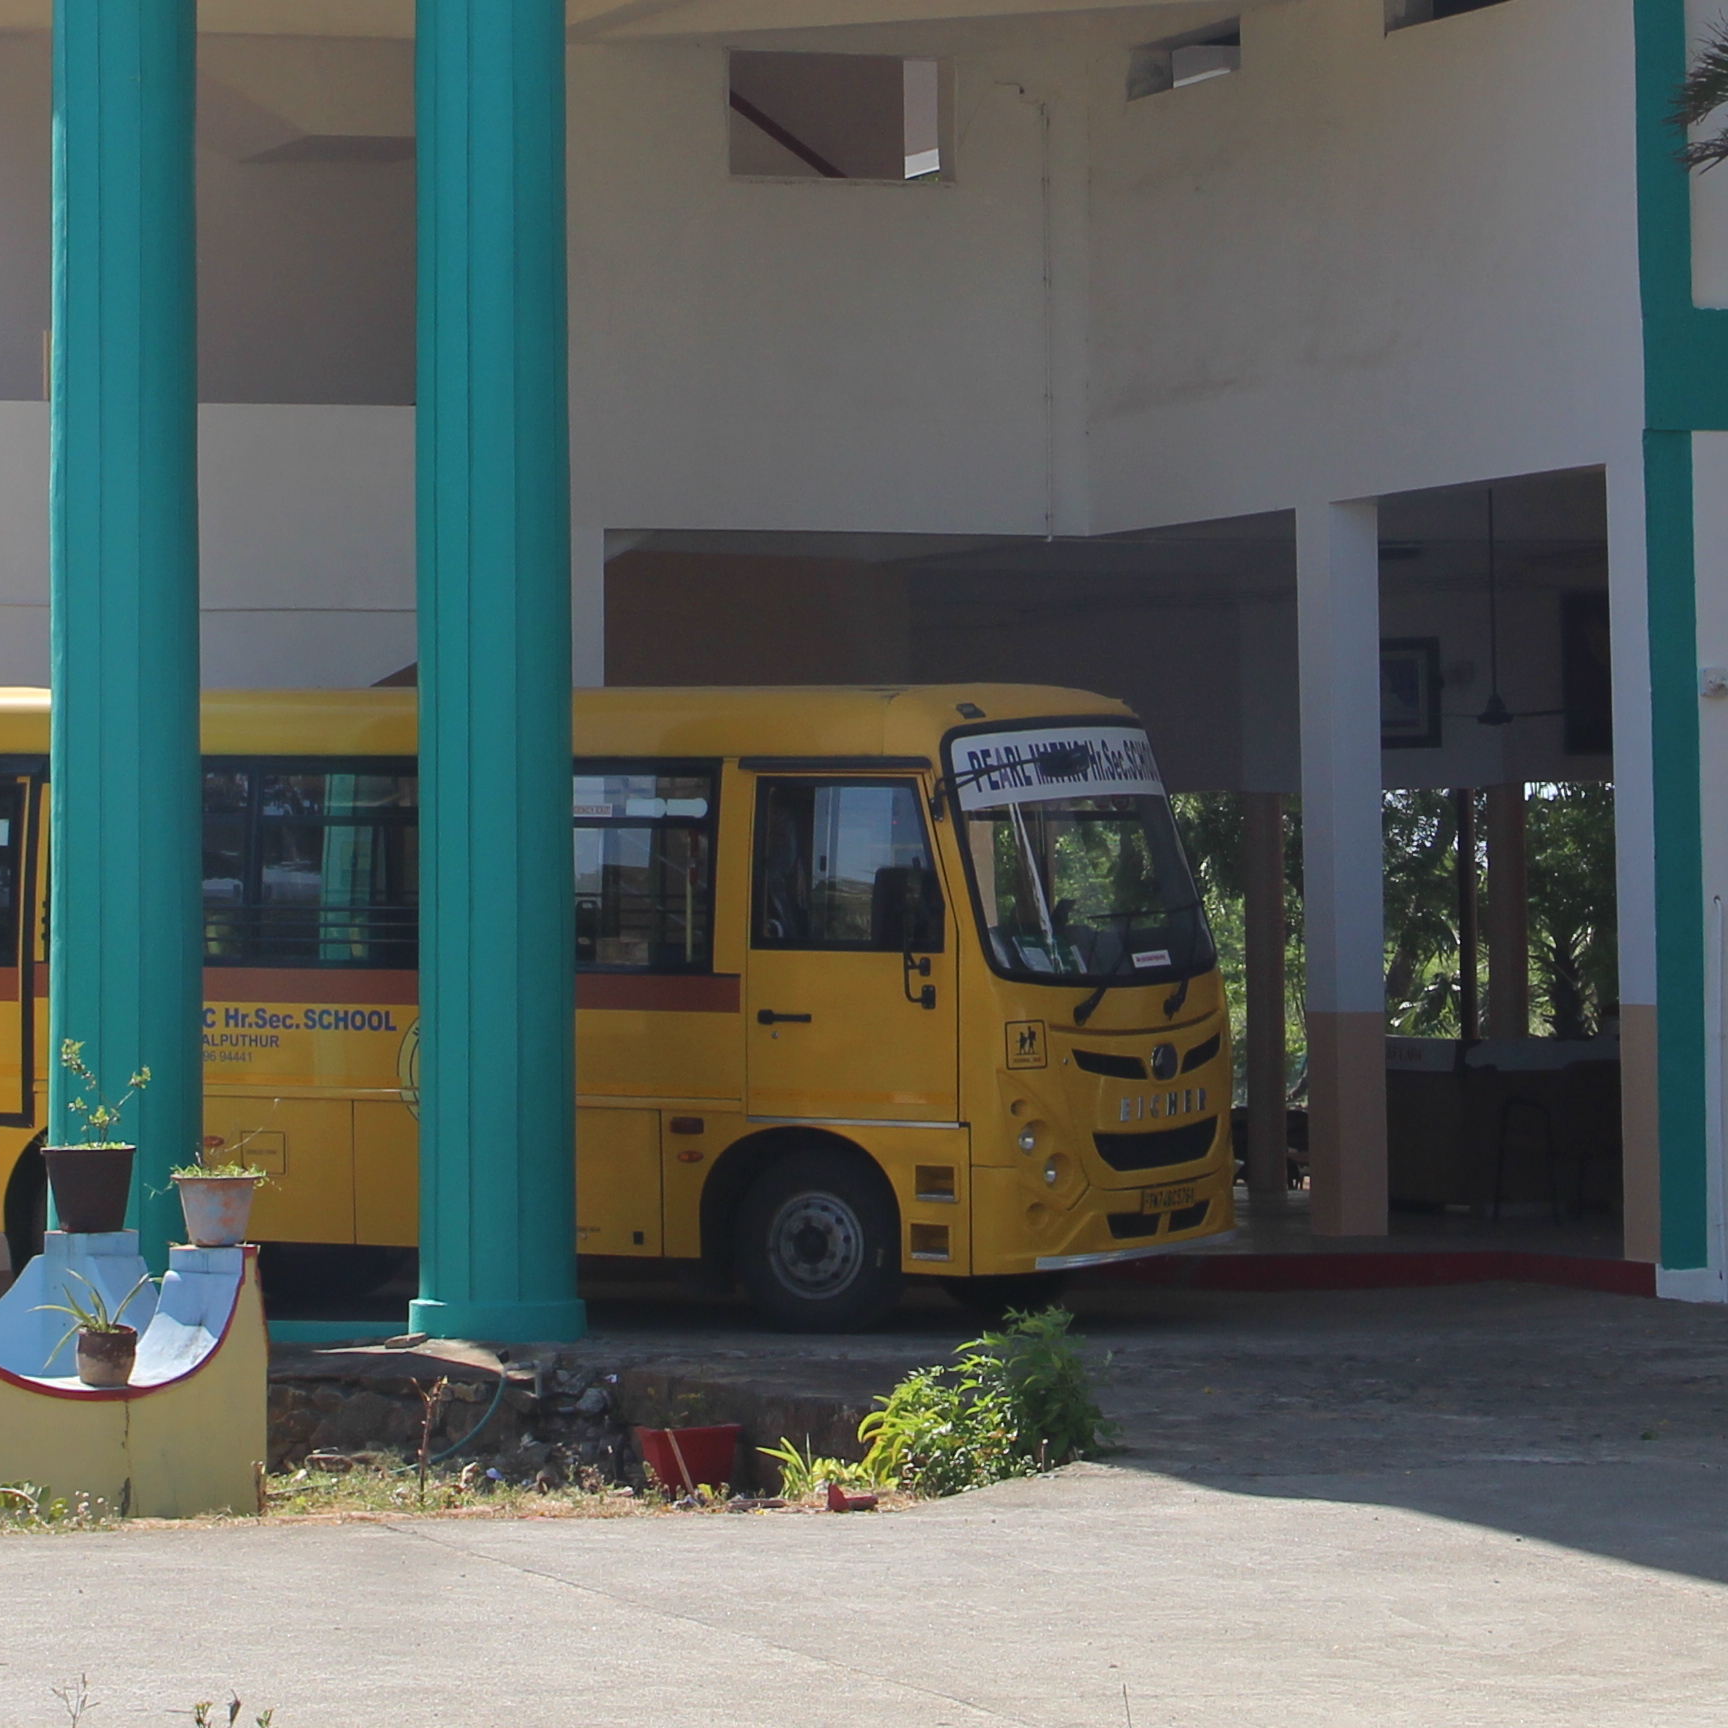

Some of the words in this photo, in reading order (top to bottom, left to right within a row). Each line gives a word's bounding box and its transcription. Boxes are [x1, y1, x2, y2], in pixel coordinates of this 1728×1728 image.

[967, 744, 1034, 793] PEARL
[303, 1009, 398, 1032] SCHOOL
[1120, 1088, 1207, 1123] EICHER
